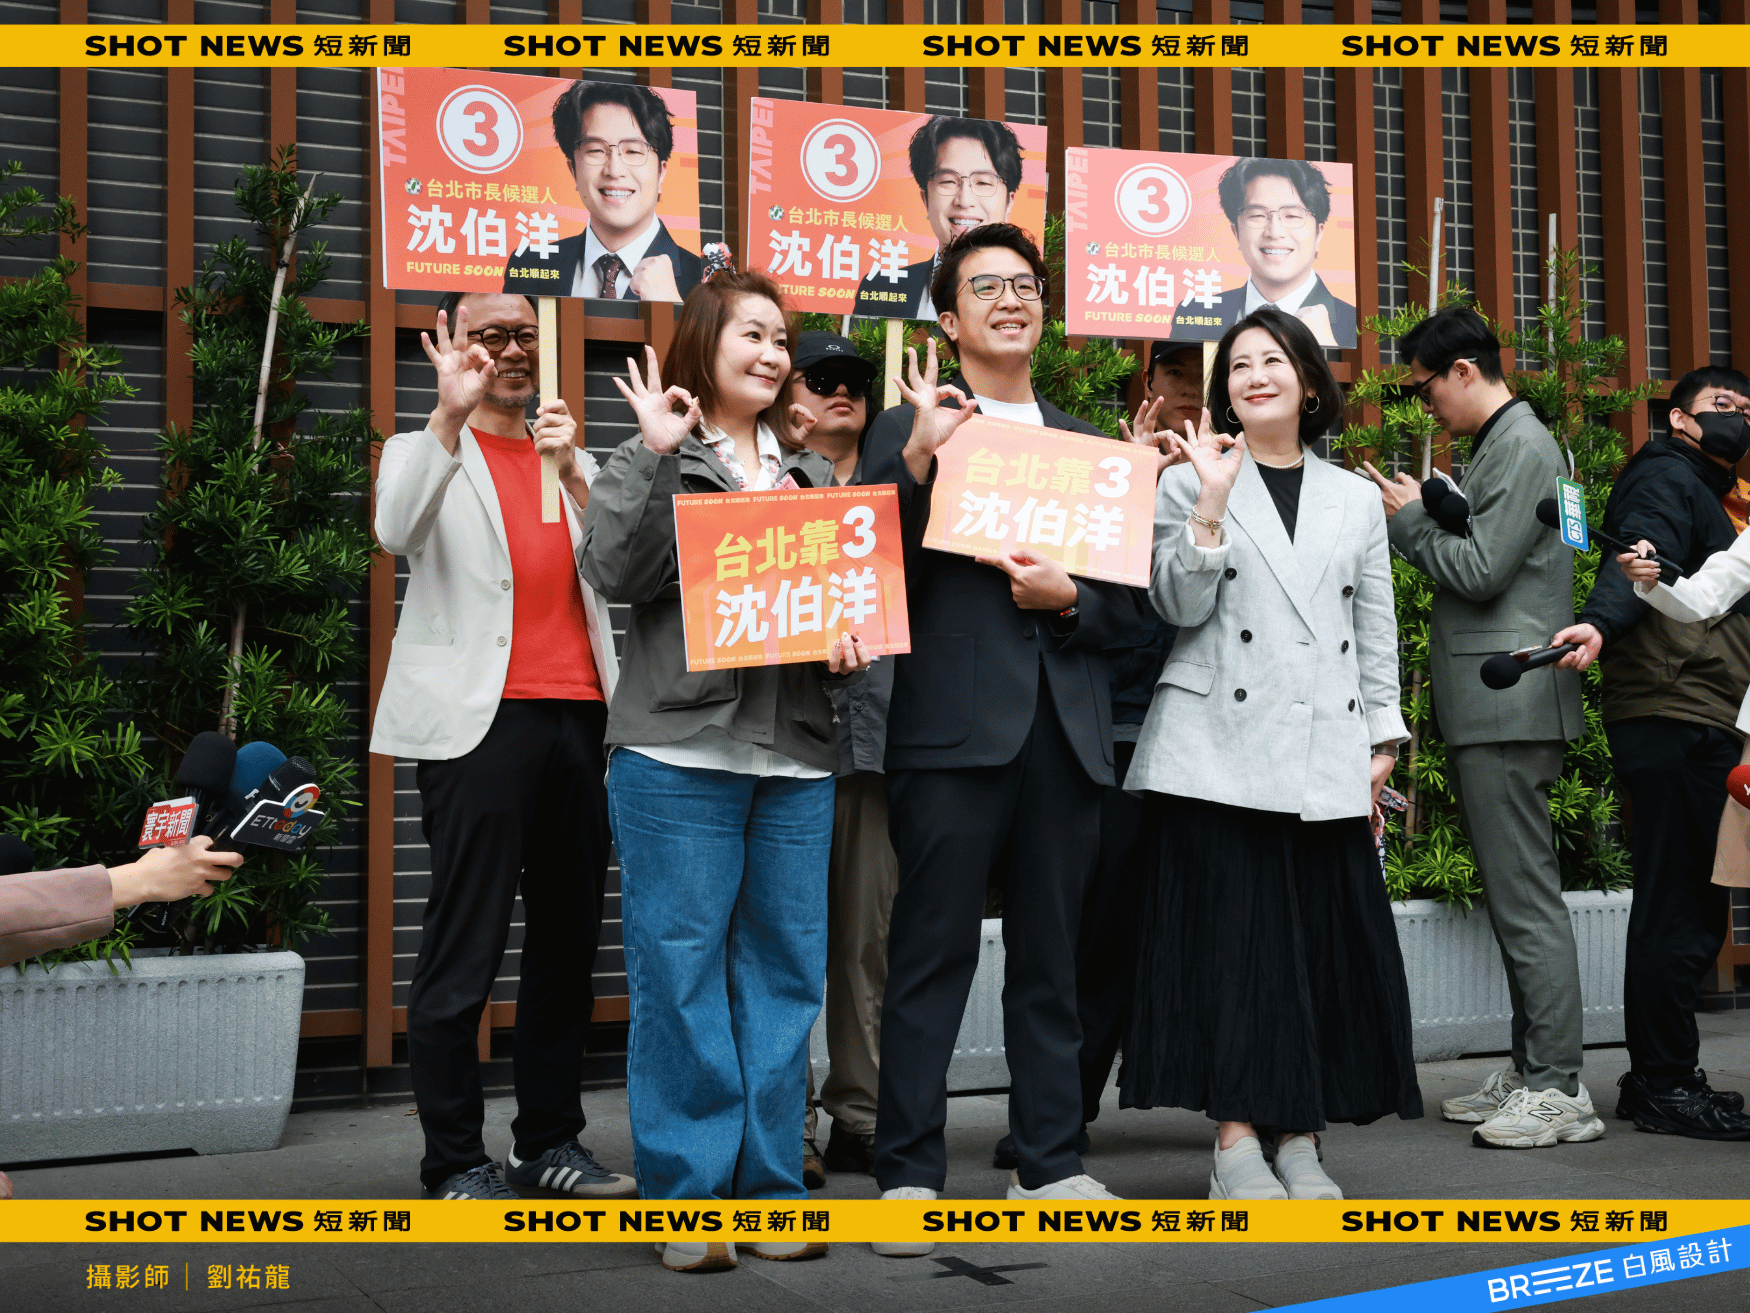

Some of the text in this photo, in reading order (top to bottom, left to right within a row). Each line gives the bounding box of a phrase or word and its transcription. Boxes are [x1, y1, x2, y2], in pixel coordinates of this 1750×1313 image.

[462, 101, 499, 157] 3
[823, 133, 859, 187] 3
[427, 179, 557, 205] 台北市長候選人
[1136, 177, 1170, 223] 3
[406, 204, 560, 260] 沈伯洋
[788, 206, 909, 232] 台北市長候選人
[406, 262, 504, 277] FUTURE SOON
[766, 229, 909, 284] 沈伯洋
[1104, 242, 1221, 263] 台北市長候選人
[779, 284, 855, 299] TURE SOON
[1085, 263, 1223, 309] 沈伯洋
[1084, 311, 1172, 324] FUTURE SOON
[965, 448, 1132, 498] 台北靠3
[951, 489, 1125, 551] 沈伯洋
[1563, 484, 1581, 541] CTS 華視
[714, 505, 877, 581] 台北靠3
[714, 566, 877, 648] 沈伯洋
[142, 808, 193, 843] 寰宇新聞
[250, 815, 312, 839] ETtoday
